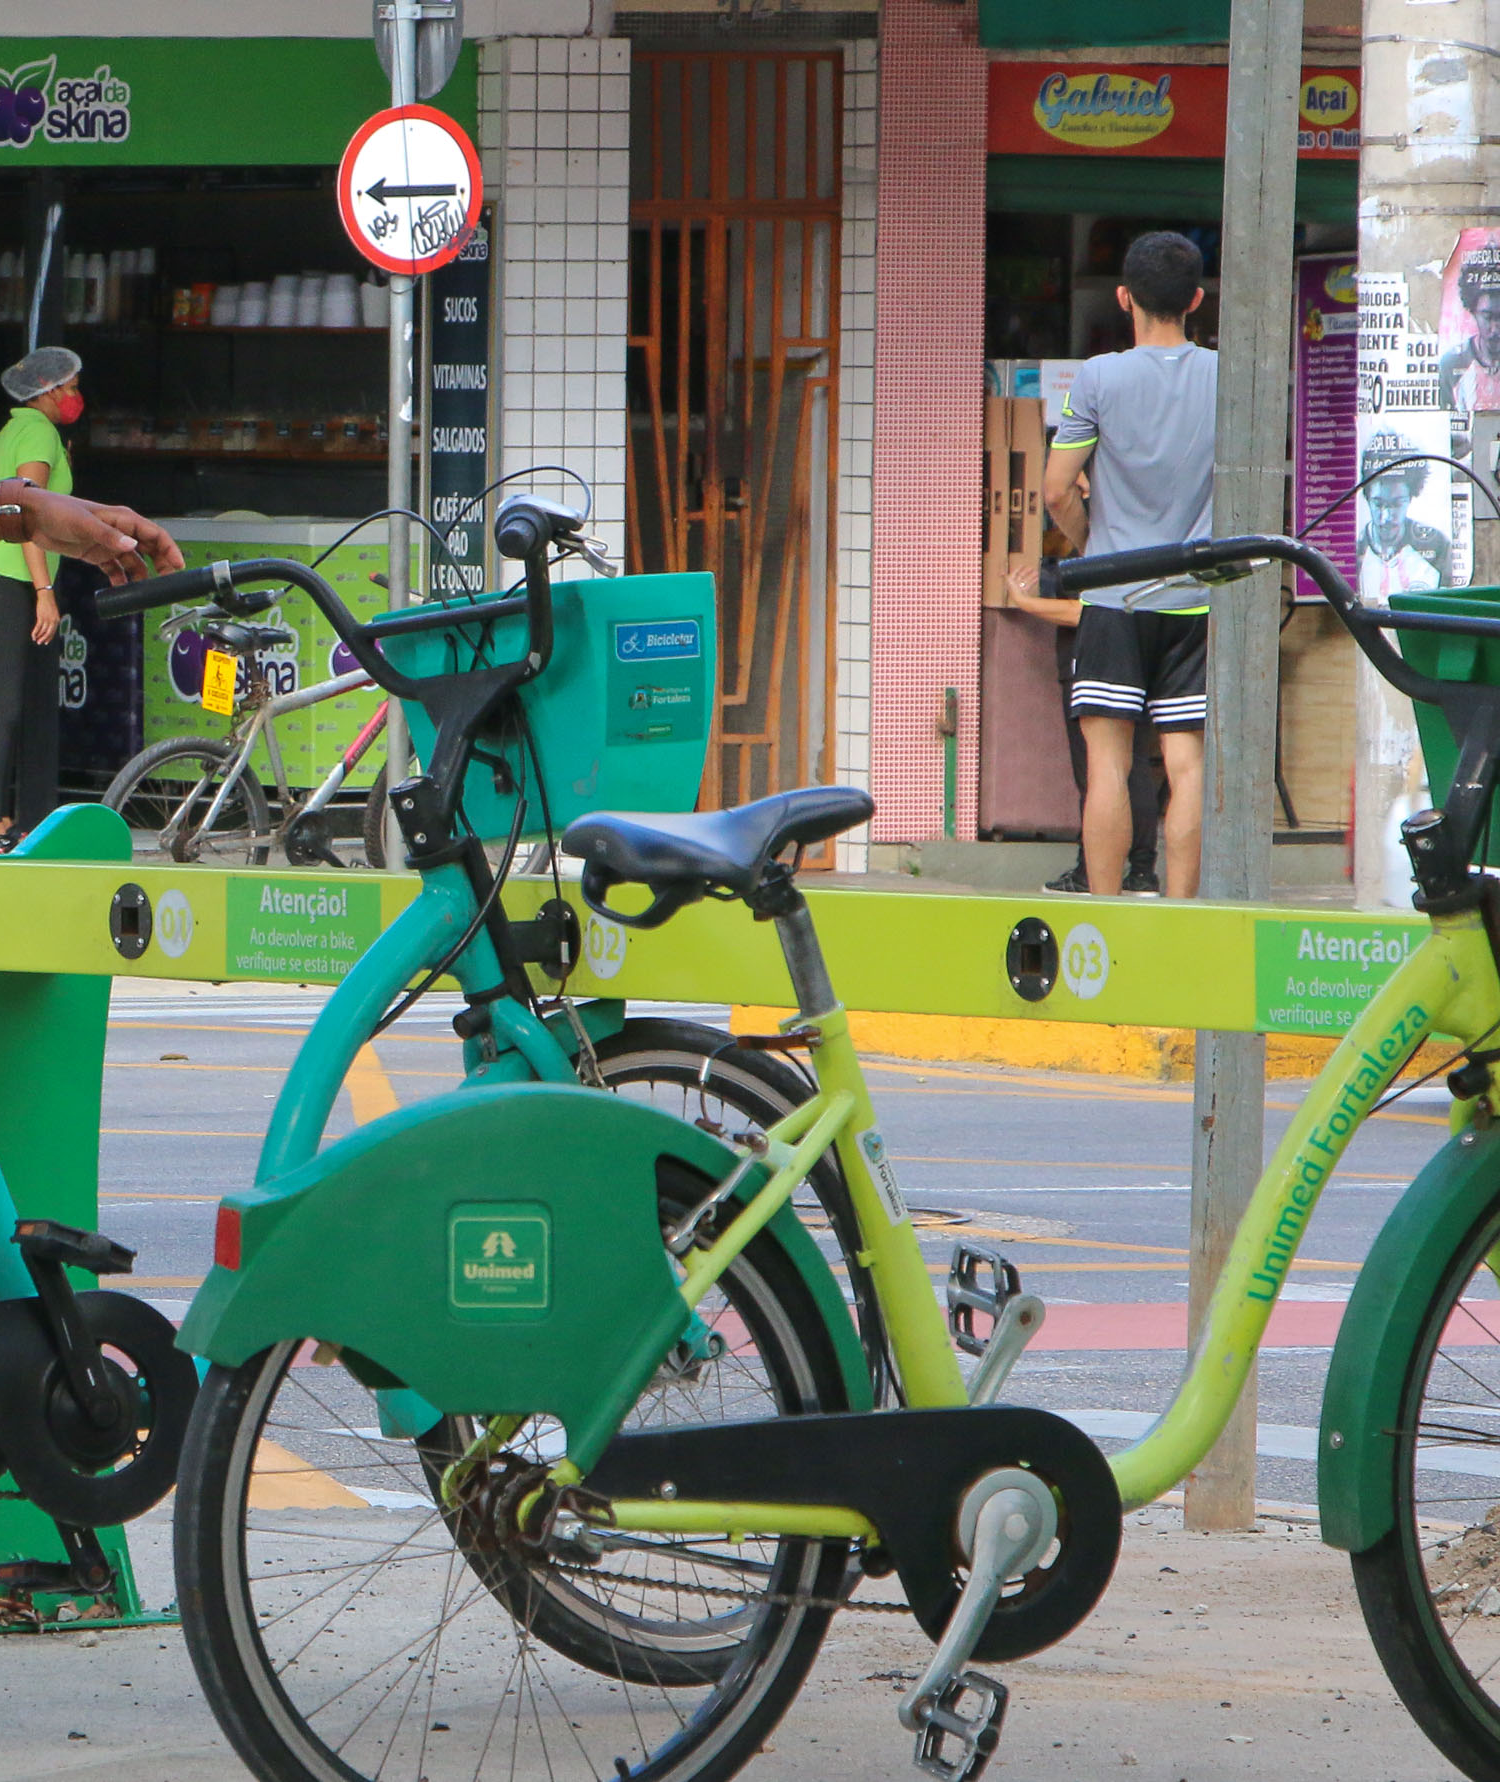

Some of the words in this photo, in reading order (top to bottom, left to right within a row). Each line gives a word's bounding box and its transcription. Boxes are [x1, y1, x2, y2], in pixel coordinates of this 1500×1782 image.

[104, 83, 127, 103] da
[1039, 72, 1171, 128] Gabriel
[1306, 85, 1348, 115] Açaí
[47, 101, 127, 138] skina
[444, 297, 478, 322] SUCOS
[433, 365, 487, 389] VITAMINAS
[1386, 389, 1440, 406] DINHEI
[432, 427, 485, 453] SALGADOS
[433, 491, 459, 522] CAFÉ
[448, 525, 468, 557] PÃO
[646, 633, 694, 647] Bicicletar
[260, 885, 348, 924] Atenção!
[161, 907, 188, 942] 01
[249, 927, 265, 946] Ao
[267, 929, 317, 949] devolver
[320, 935, 327, 949] a
[330, 932, 358, 952] bike,
[590, 924, 620, 961] 02
[1298, 928, 1409, 971] Atenção!
[236, 951, 286, 975] verifique
[289, 957, 301, 972] se
[304, 954, 328, 973] está
[331, 958, 353, 974] trav
[1068, 942, 1101, 979] 03
[1286, 976, 1305, 997] Ao
[1309, 977, 1372, 999] devolver
[1269, 1004, 1324, 1027] verifique
[1329, 1009, 1351, 1025] se
[1248, 1156, 1324, 1303] Unimed
[1308, 1004, 1429, 1156] Fortaleza
[463, 1263, 535, 1279] Unimed
